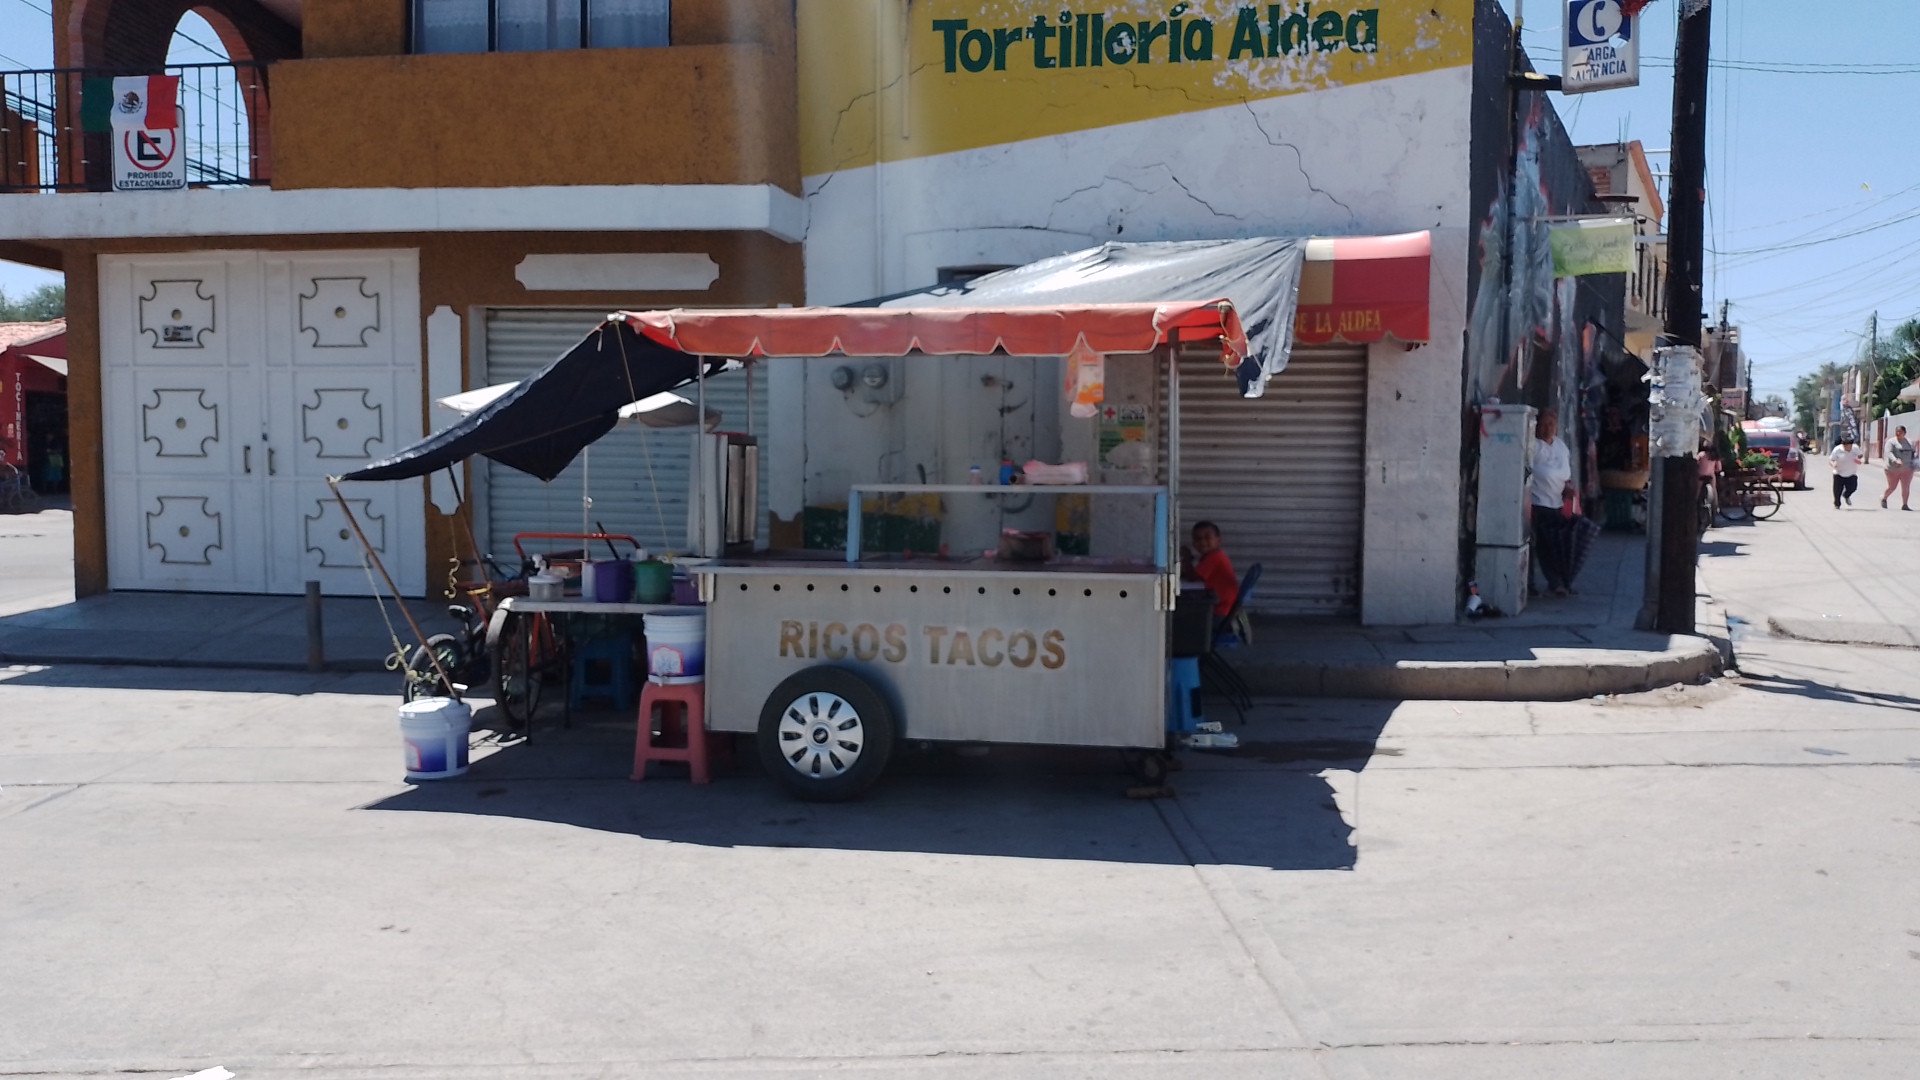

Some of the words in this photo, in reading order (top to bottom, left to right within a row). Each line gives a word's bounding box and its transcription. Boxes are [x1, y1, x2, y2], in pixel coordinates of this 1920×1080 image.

[1228, 2, 1379, 60] Aldea
[1584, 46, 1616, 61] ARGA
[119, 179, 182, 187] ESTACIONARSE
[127, 171, 174, 179] PROHIBIDO
[1315, 312, 1333, 333] LA
[1338, 310, 1381, 332] ALDEA
[779, 620, 908, 663] RICOS
[923, 624, 1067, 669] TACOS
